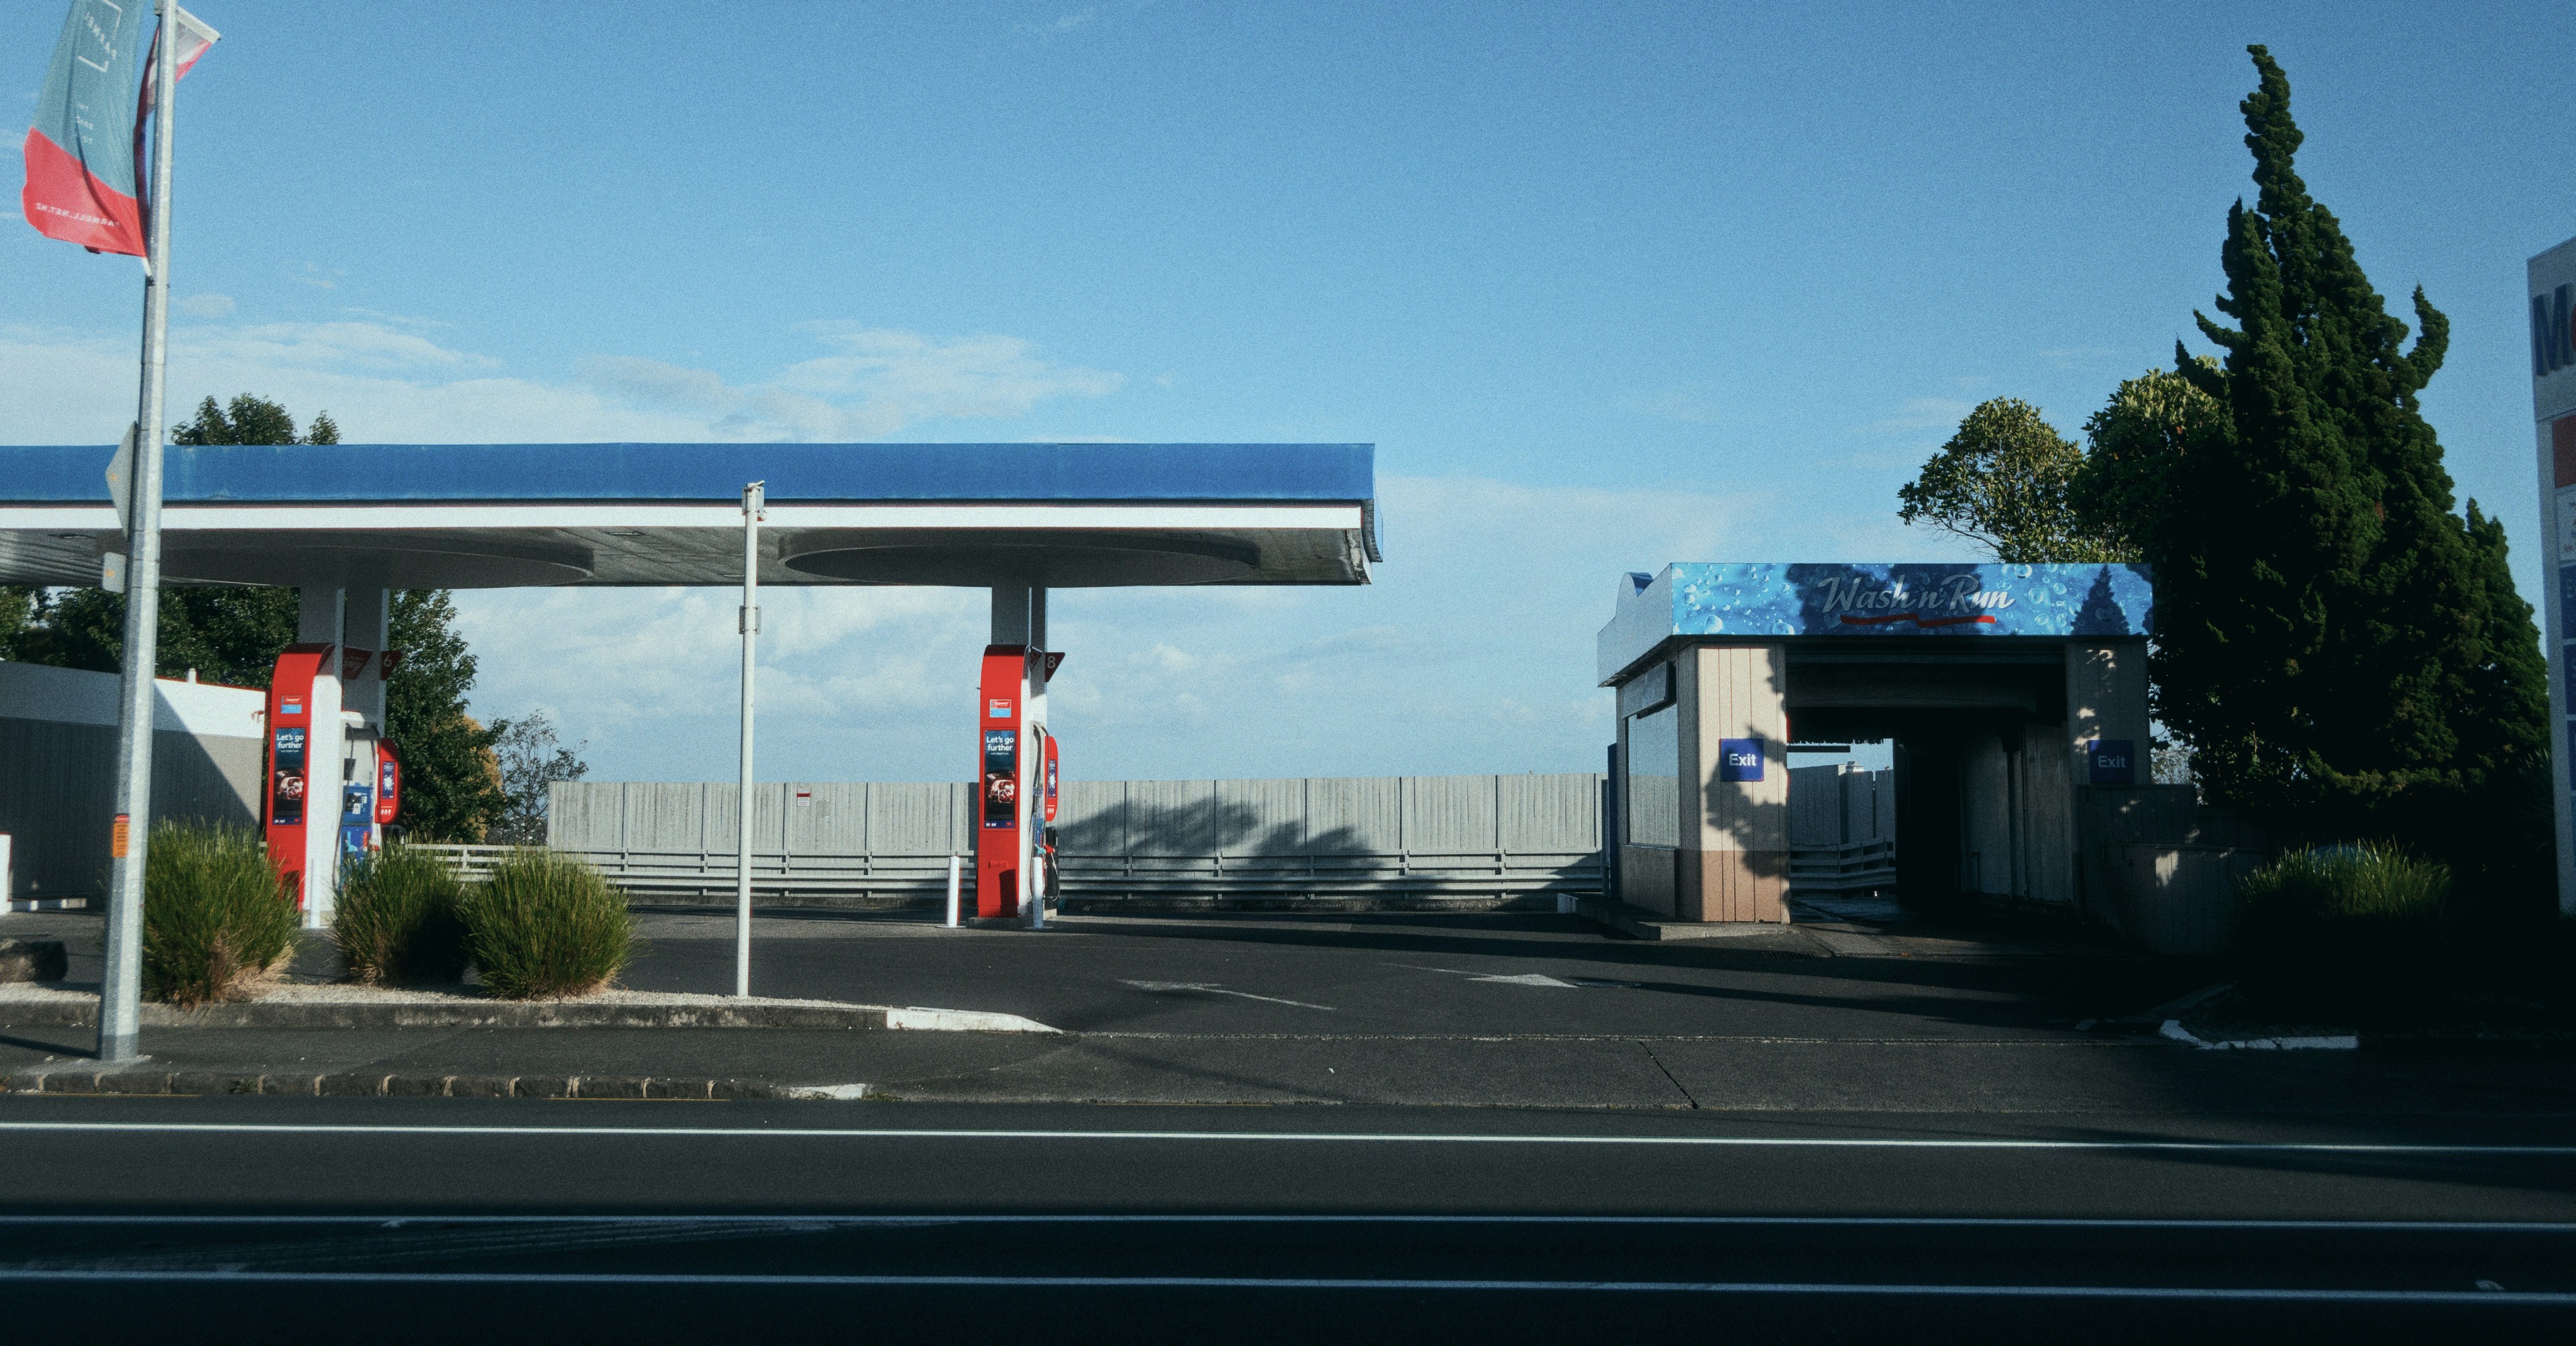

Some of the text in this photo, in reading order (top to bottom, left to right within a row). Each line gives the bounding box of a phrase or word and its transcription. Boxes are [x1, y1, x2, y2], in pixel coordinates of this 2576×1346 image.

[1817, 574, 1917, 613] Wash
[1941, 574, 2017, 613] Run
[383, 654, 393, 668] 6
[1046, 655, 1056, 669] 8
[278, 741, 303, 749] further
[1729, 754, 1757, 766] Exit
[2098, 755, 2126, 768] Exit
